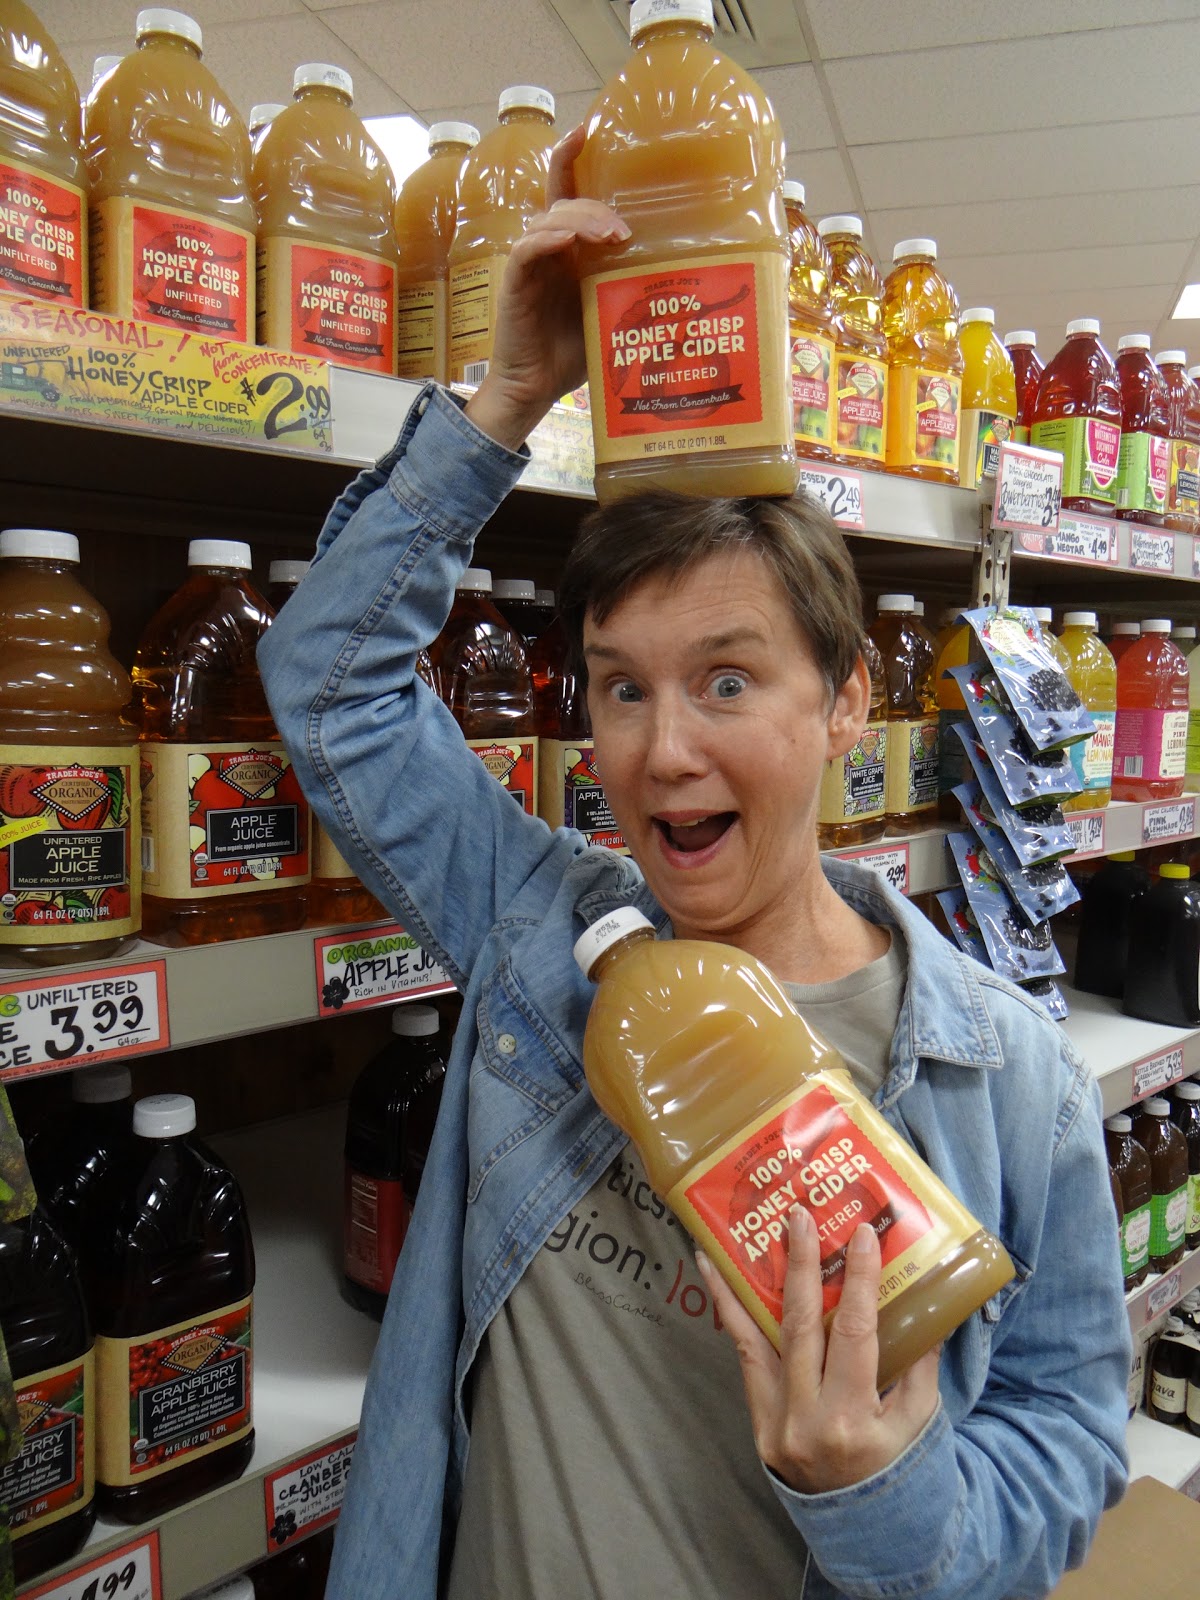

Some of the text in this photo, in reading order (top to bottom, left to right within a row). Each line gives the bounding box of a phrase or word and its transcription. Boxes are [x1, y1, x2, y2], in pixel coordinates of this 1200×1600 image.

[6, 187, 47, 214] 100%
[35, 219, 75, 244] CRISP
[31, 233, 75, 261] CIDER
[175, 235, 214, 257] 100%
[143, 248, 240, 283] HONEY CRISP
[474, 268, 489, 277] Facts
[143, 262, 240, 298] APPLE CIDER
[330, 269, 364, 287] 100%
[644, 278, 701, 294] TRADER JOE'S
[165, 288, 222, 309] UNFILTERED
[301, 282, 388, 311] HONEY CRISP
[157, 306, 171, 317] Not
[301, 296, 388, 325] APPLE CIDER
[648, 294, 701, 317] 100%
[320, 319, 371, 336] UNFILTERED
[611, 316, 745, 348] HONEY CRISP
[3, 345, 71, 359] UNFILTERED
[87, 348, 137, 369] 100%
[613, 334, 745, 367] APPLE CIDER
[64, 356, 212, 398] HONEY CRISP
[641, 367, 719, 386] UNFILTERED
[140, 389, 250, 417] APPLE CIDER
[633, 392, 731, 412] Not From Concentrate
[810, 390, 827, 402] JUICE
[842, 405, 882, 419] APPLE JUICE
[921, 419, 955, 431] APPLE JUICE
[644, 442, 656, 453] NET
[657, 441, 666, 451] 64
[667, 440, 676, 450] FL
[677, 439, 687, 449] OZ
[708, 435, 727, 446] 1.89L
[801, 472, 826, 484] ESSED
[1024, 469, 1054, 483] CHOCOLATE
[1055, 531, 1080, 543] MANGO
[1057, 543, 1085, 556] NECTAR
[229, 755, 272, 765] TRADER JOE'S
[477, 748, 495, 758] TRADER
[485, 761, 508, 771] RGANIC
[852, 767, 884, 779] WHITE GRAPE
[915, 762, 928, 771] WHITE
[922, 769, 934, 777] JUICE
[46, 770, 99, 780] TRADER JOE'S
[231, 770, 274, 782] ORGANIC
[861, 775, 876, 785] JUICE
[48, 787, 99, 798] ORGANIC
[20, 820, 43, 836] JUICE
[231, 814, 277, 829] APPLE
[1149, 816, 1166, 826] PINK
[1149, 821, 1178, 833] LEMONADE
[43, 836, 102, 846] UNFILTERED
[233, 827, 274, 842] JUICE
[46, 846, 101, 860] APPLE
[215, 845, 227, 853] From
[49, 860, 99, 875] JUICE
[223, 866, 248, 877] 64 FL OZ
[33, 910, 43, 919] 64
[45, 909, 54, 919] FL
[56, 908, 66, 919] OZ
[67, 908, 76, 919] (2
[77, 907, 94, 919] QTS)
[327, 936, 420, 965] ORGANIC
[342, 953, 410, 988] APPLE
[27, 979, 138, 1010] UNFILTERED
[45, 995, 144, 1061] 3.99
[734, 1142, 763, 1173] TRADER
[749, 1144, 803, 1190] 100%
[809, 1153, 872, 1206] CIDER
[729, 1137, 855, 1244] HONEY CRISP
[899, 1263, 921, 1282] 1.89L
[171, 1327, 216, 1349] TRADER JOE'S
[173, 1339, 217, 1363] ORGANIC
[152, 1362, 237, 1403] CRANBERRY
[151, 1374, 237, 1417] APPLE JUICE
[165, 1446, 173, 1456] 64
[174, 1443, 181, 1452] FL
[182, 1439, 191, 1448] OZ
[18, 1444, 64, 1473] JUICE
[300, 1461, 322, 1477] LOW
[279, 1457, 352, 1500] CRANBER
[301, 1474, 342, 1503] JUICE
[300, 1500, 322, 1515] WITH
